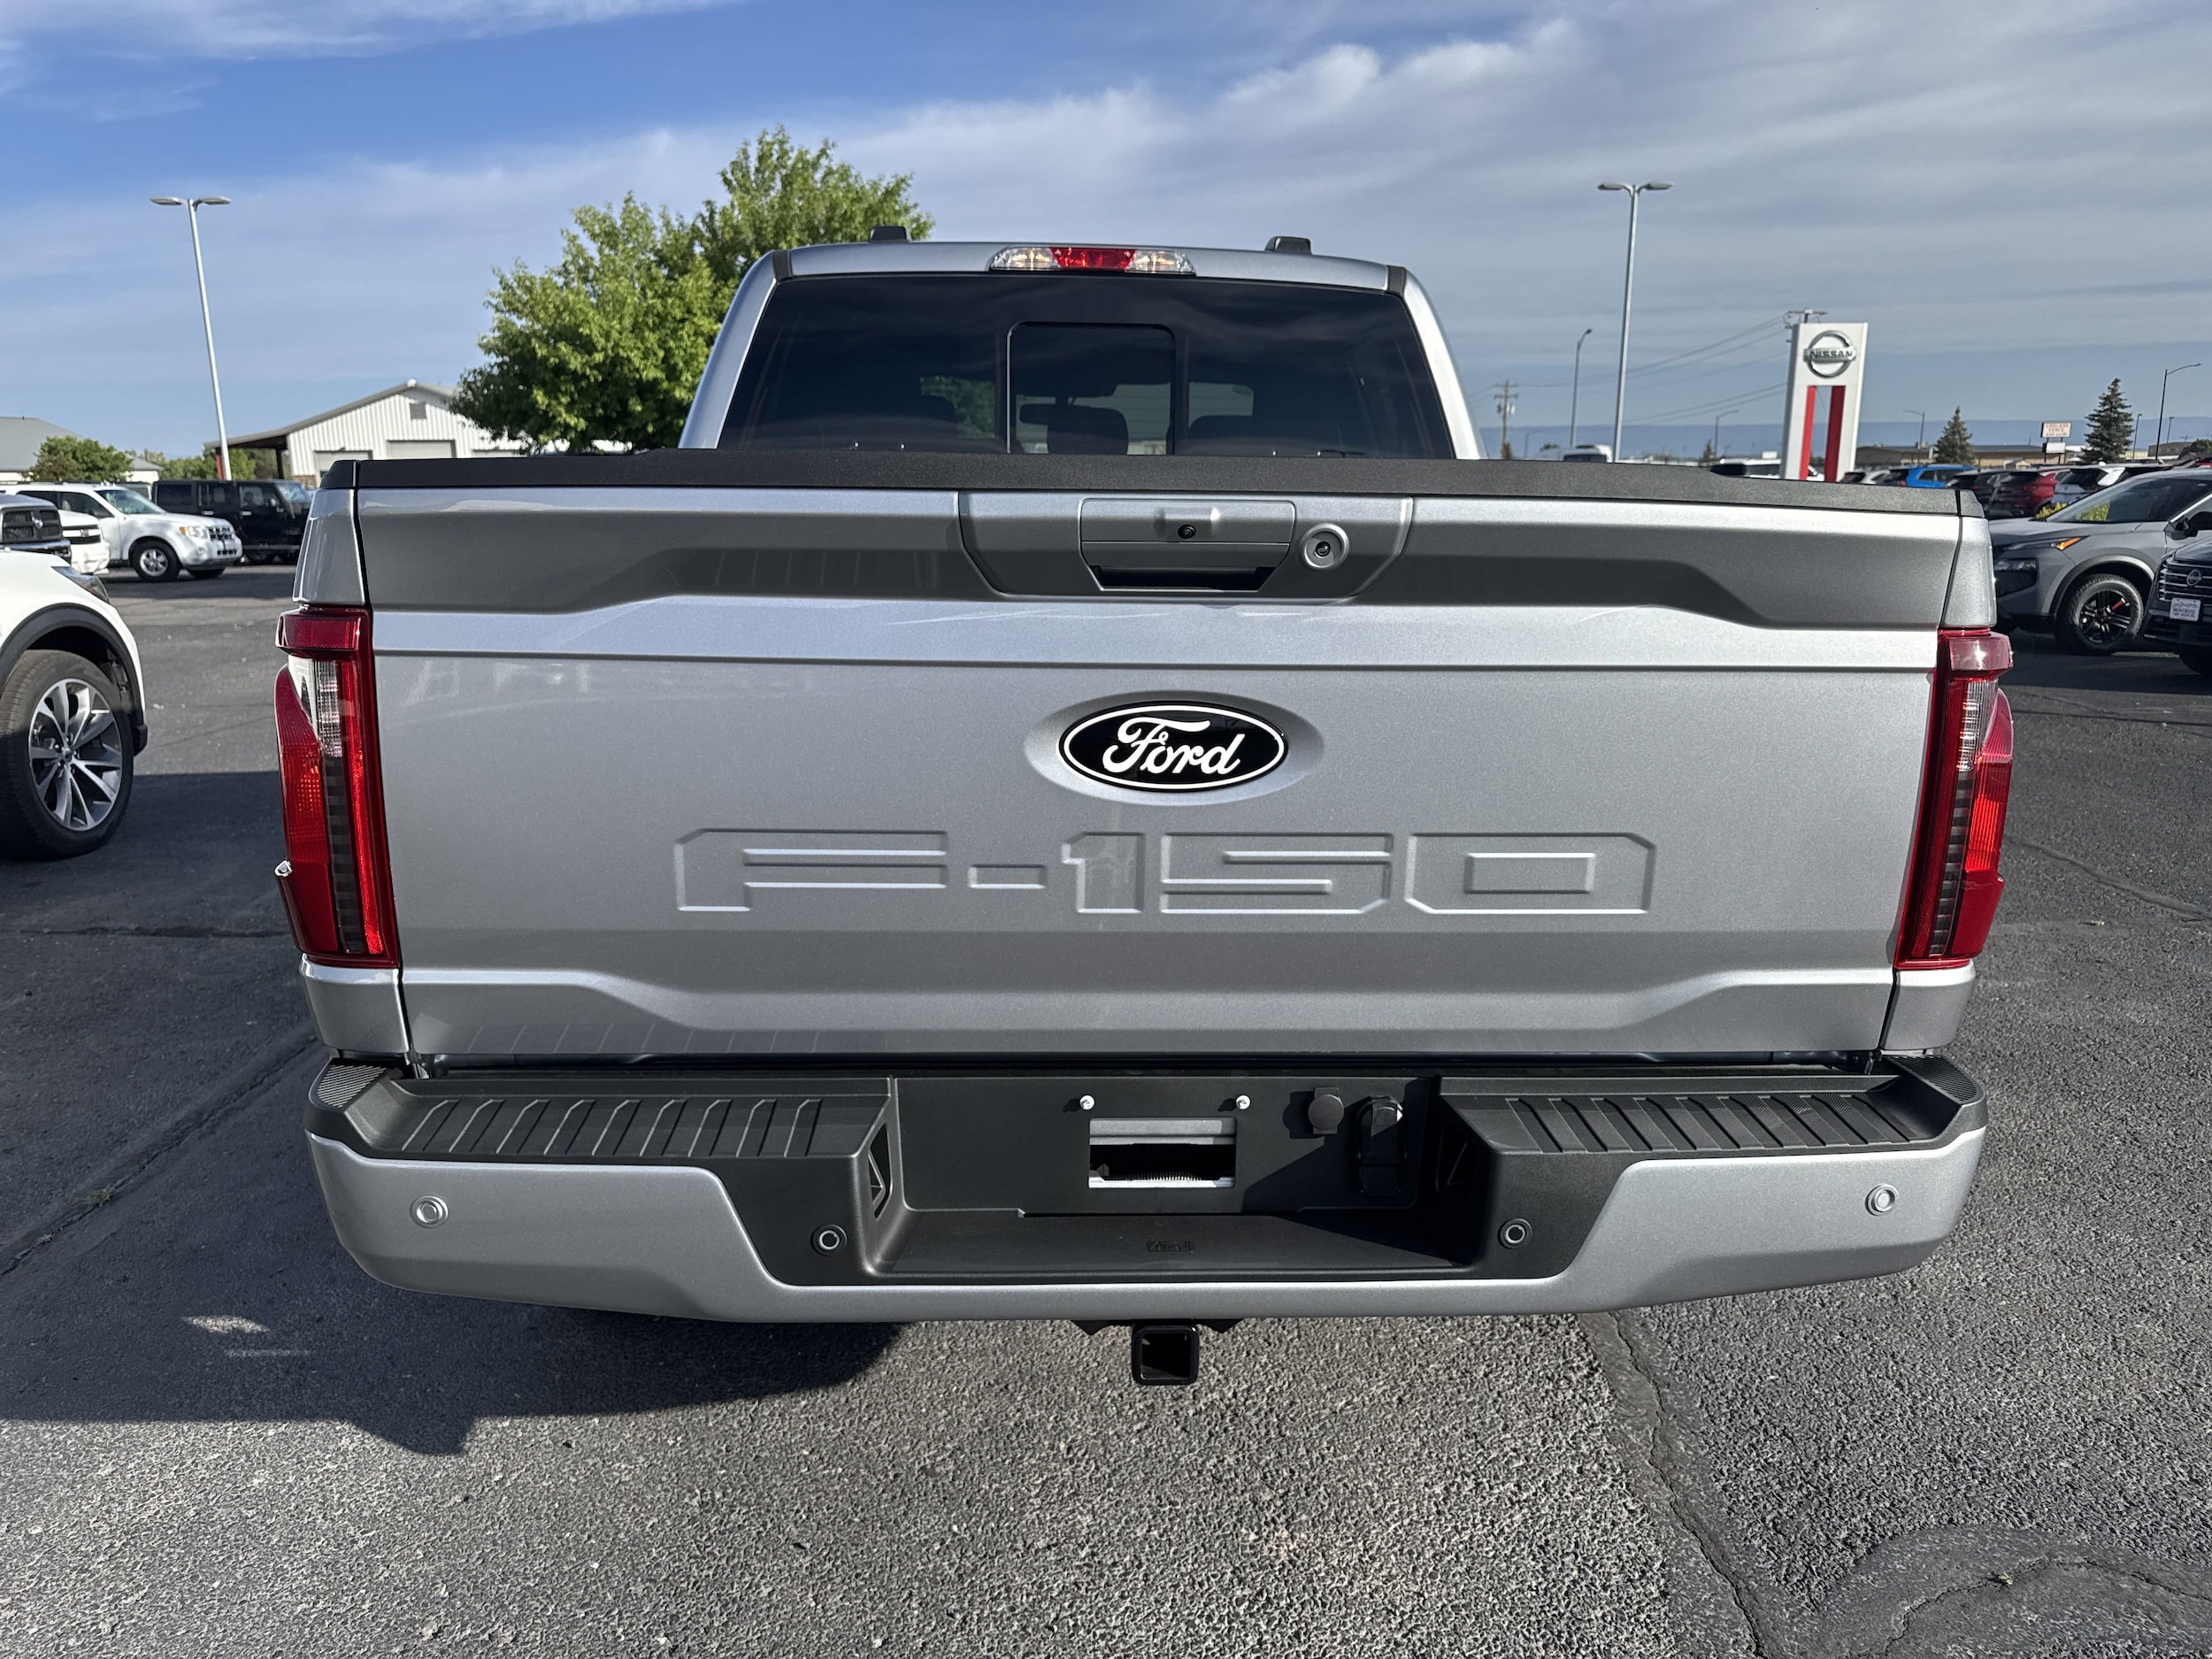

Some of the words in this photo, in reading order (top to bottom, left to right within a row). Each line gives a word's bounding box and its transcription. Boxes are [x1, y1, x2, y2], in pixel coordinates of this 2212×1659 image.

[1809, 349, 1853, 358] NISSAN
[1102, 717, 1245, 774] Ford
[674, 828, 1656, 913] F-150
